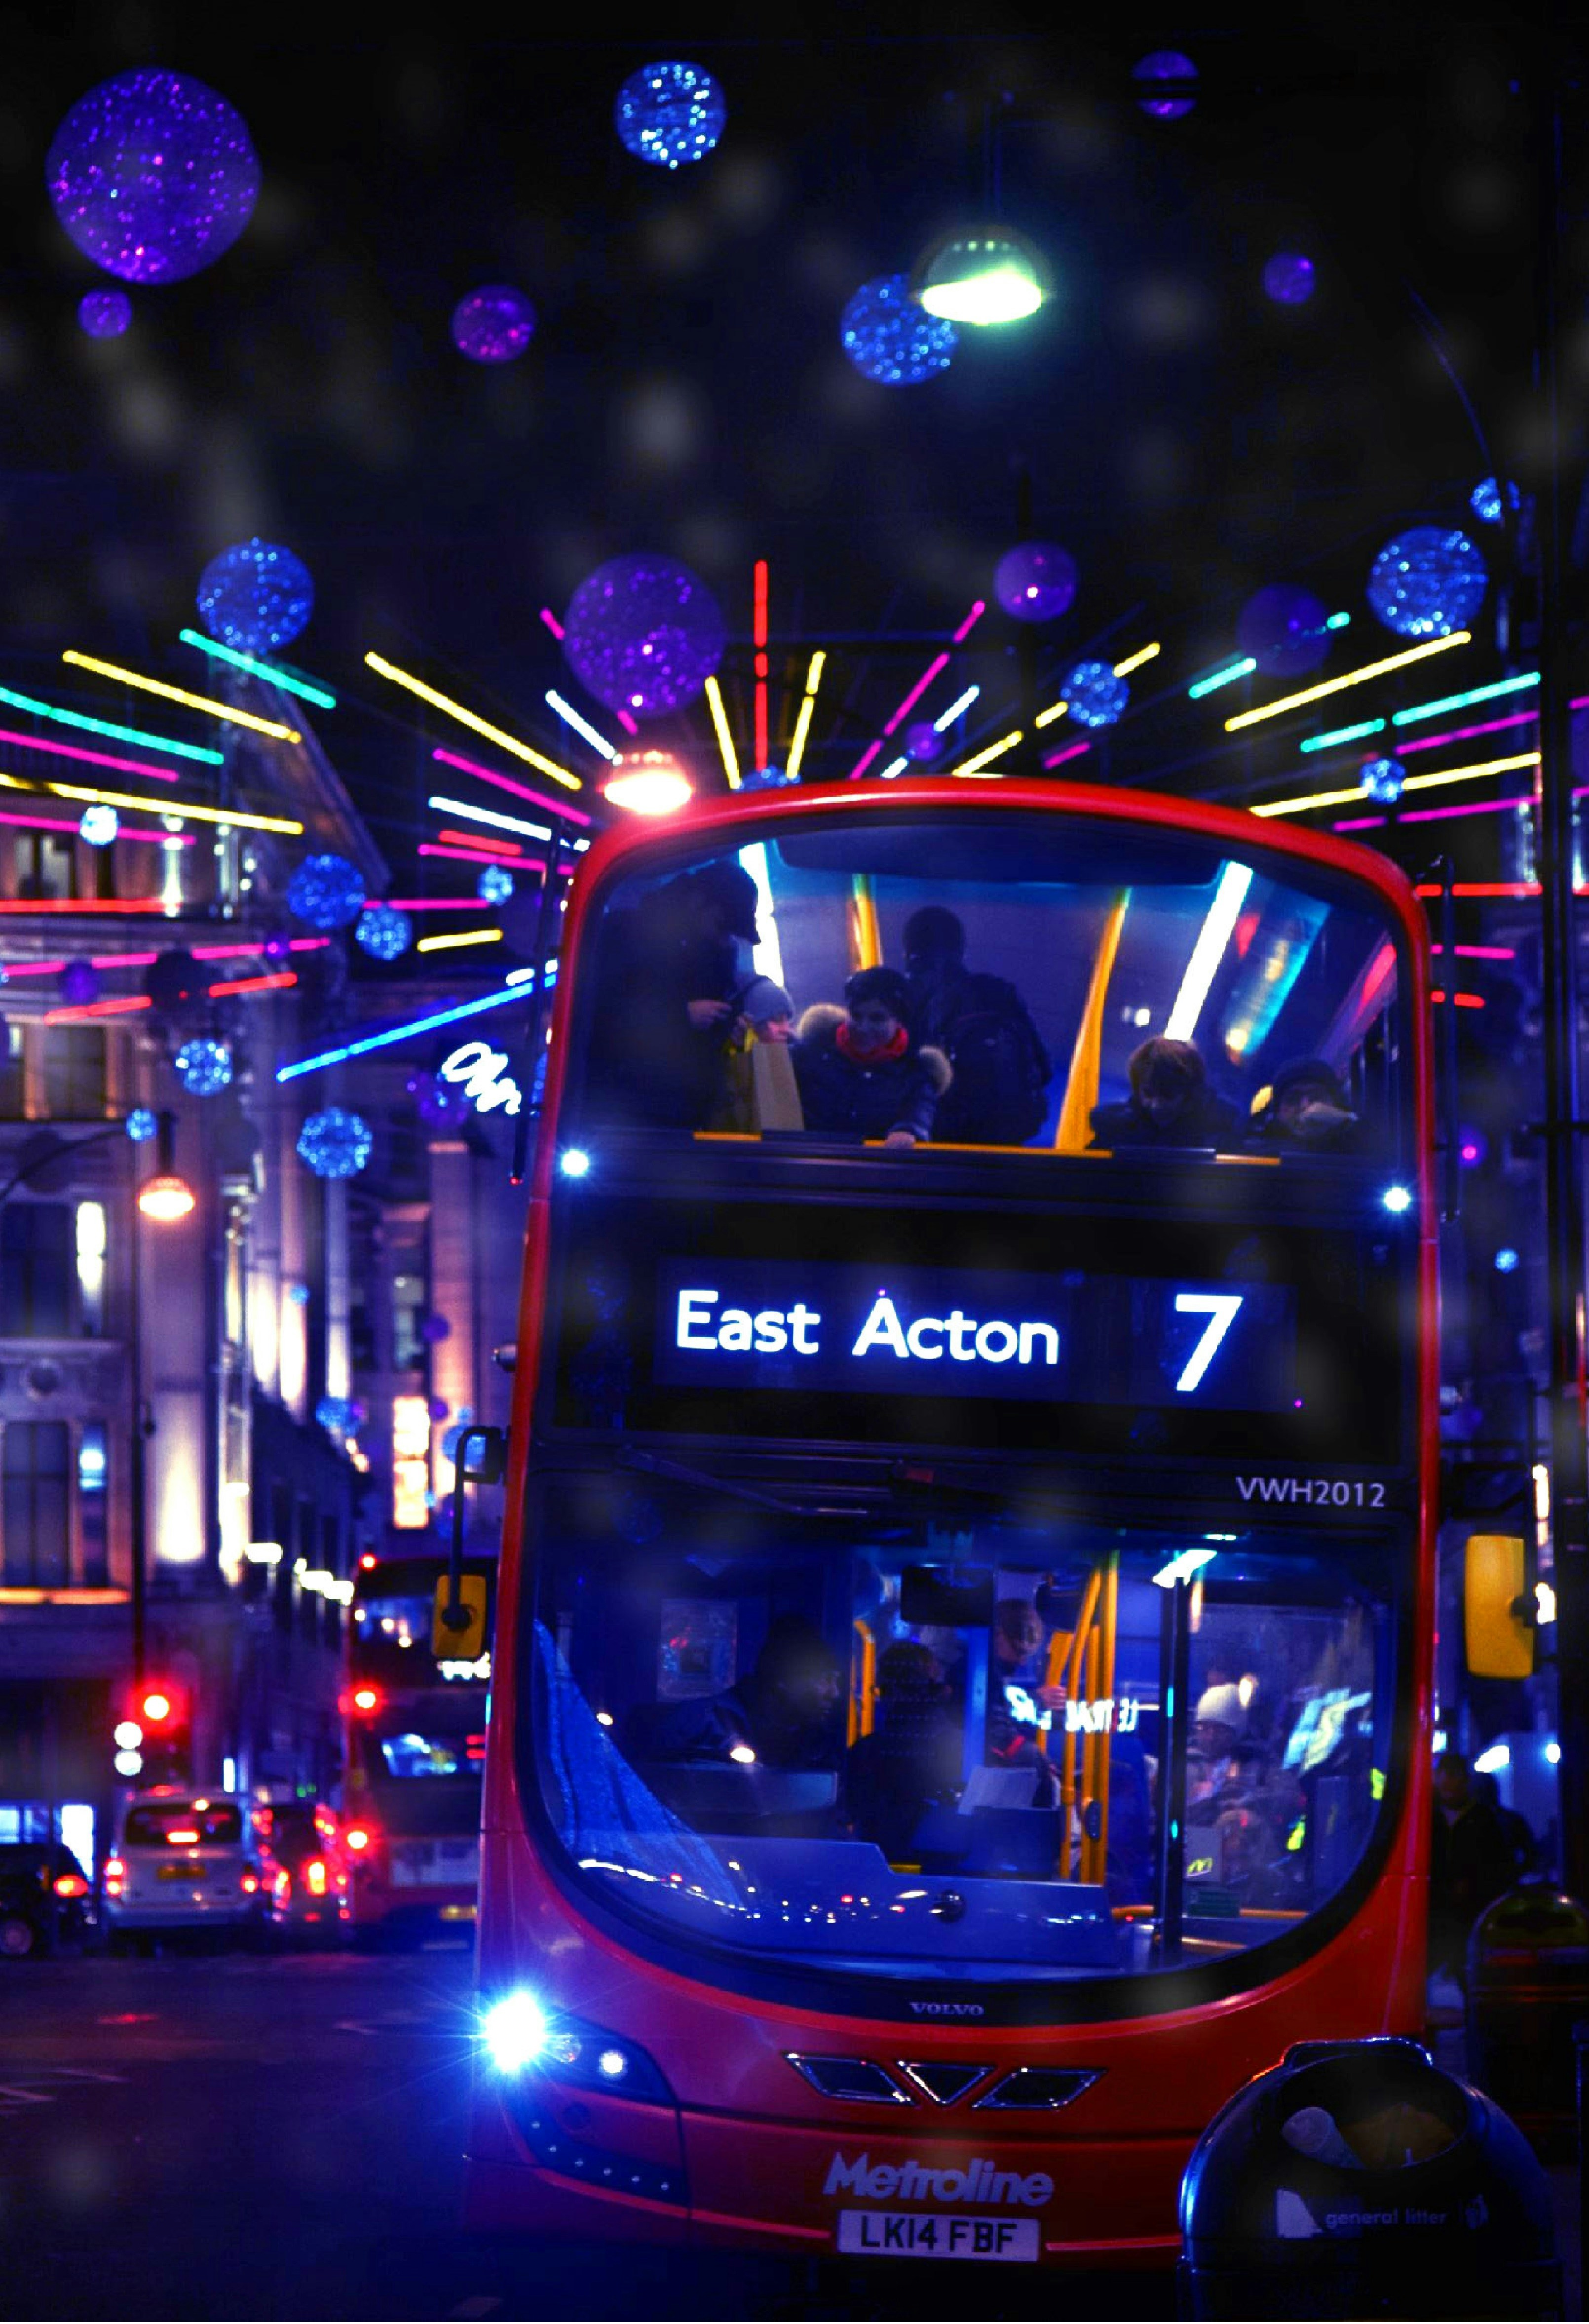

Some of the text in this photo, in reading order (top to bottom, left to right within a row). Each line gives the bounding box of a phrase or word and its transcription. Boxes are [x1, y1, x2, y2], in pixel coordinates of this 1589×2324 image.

[677, 1289, 1244, 1392] East Acton 7
[1235, 1476, 1385, 1507] VWH2012
[909, 2002, 984, 2016] VOLVO
[822, 2151, 1055, 2207] Metroline
[860, 2215, 1018, 2253] LK14 FBF
[1325, 2207, 1448, 2230] general litter
